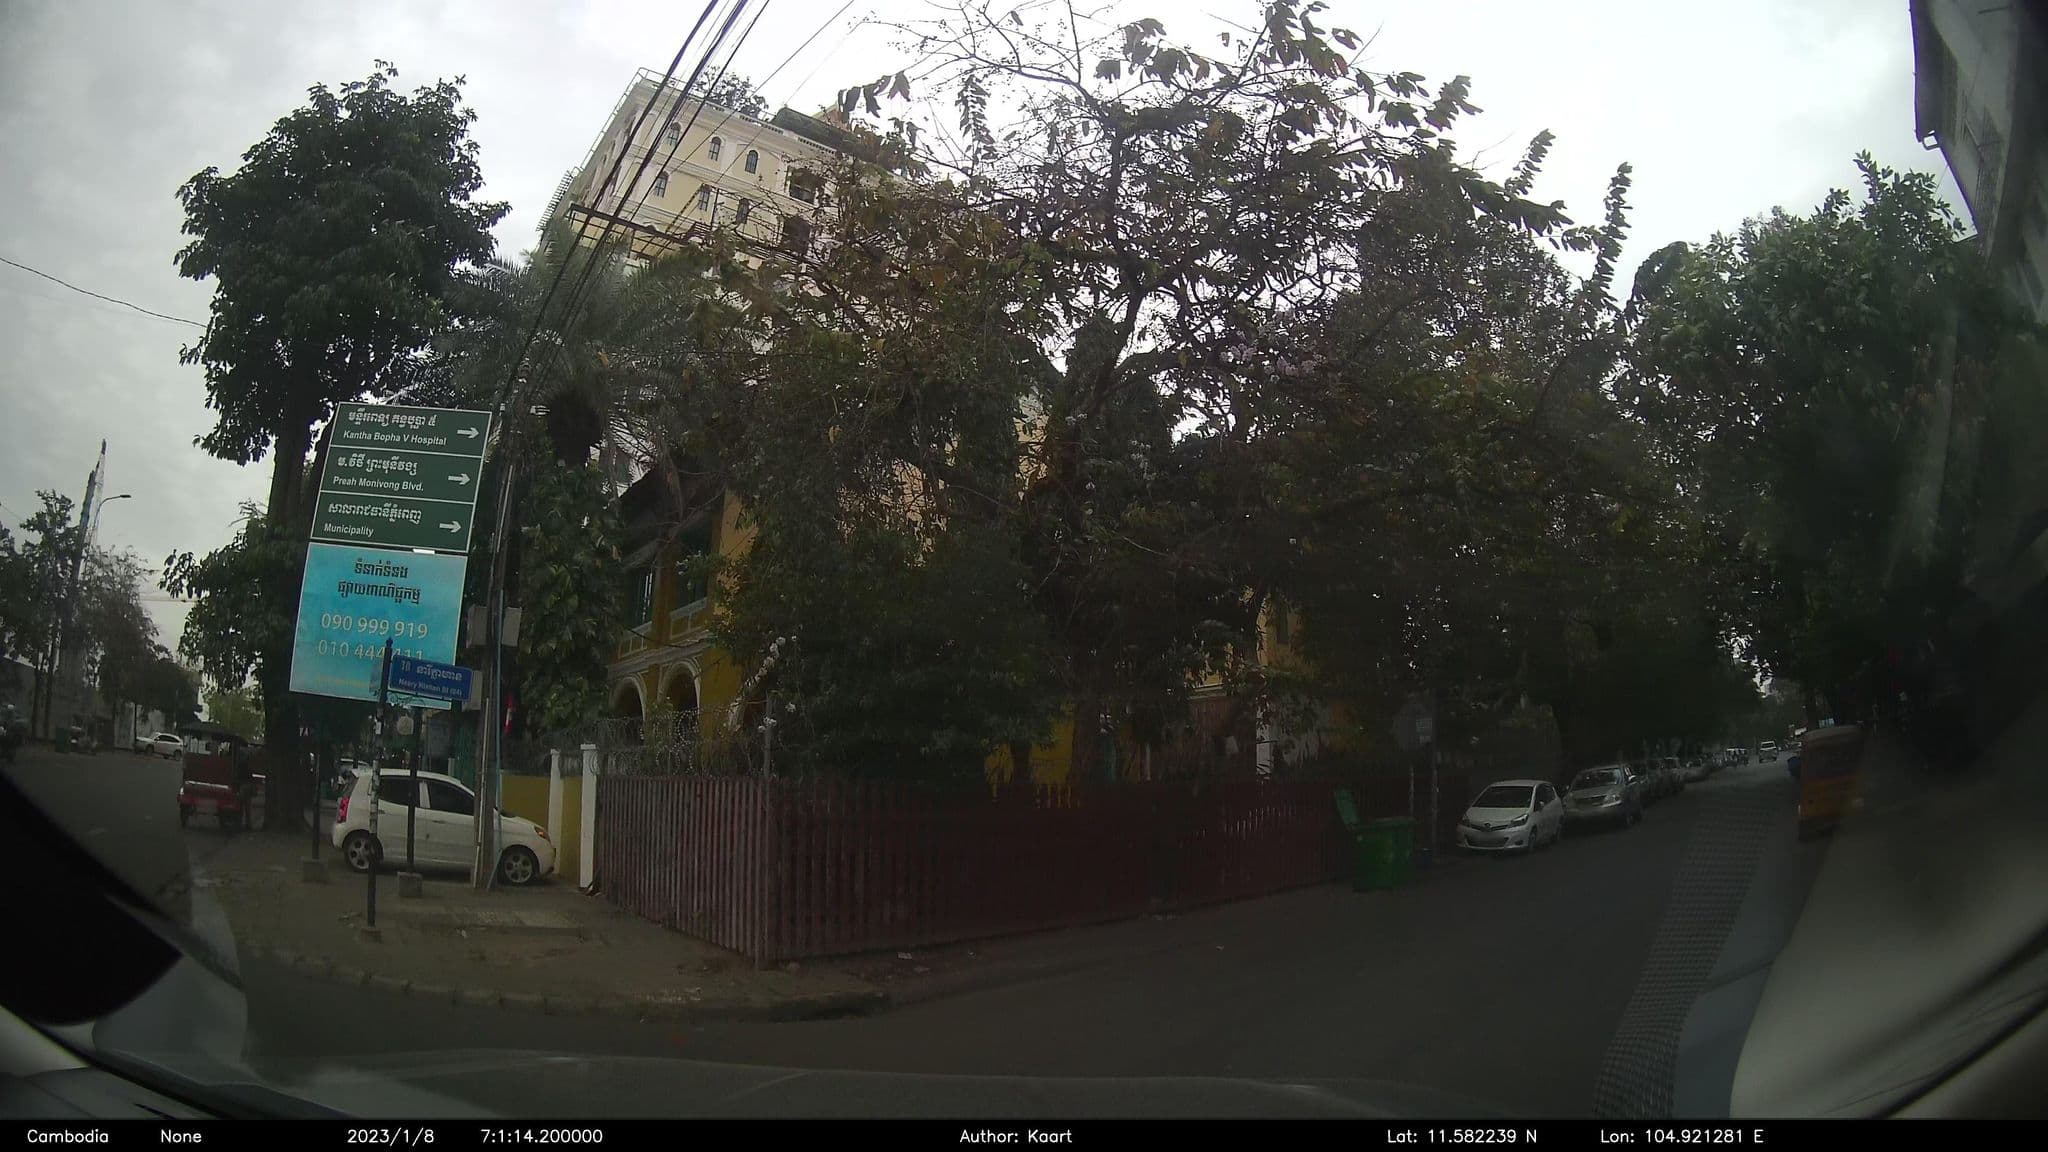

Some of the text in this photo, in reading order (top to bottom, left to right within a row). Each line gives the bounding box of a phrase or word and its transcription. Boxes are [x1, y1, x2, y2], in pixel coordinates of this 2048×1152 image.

[343, 430, 447, 447] Kantha Bopha V Hospital
[333, 476, 424, 491] Preah Monivong Blvd.
[324, 522, 374, 537] Municipality
[354, 557, 408, 579] ទំនាក់ទំនង
[321, 613, 428, 639] 090 999 919
[318, 639, 350, 657] 010
